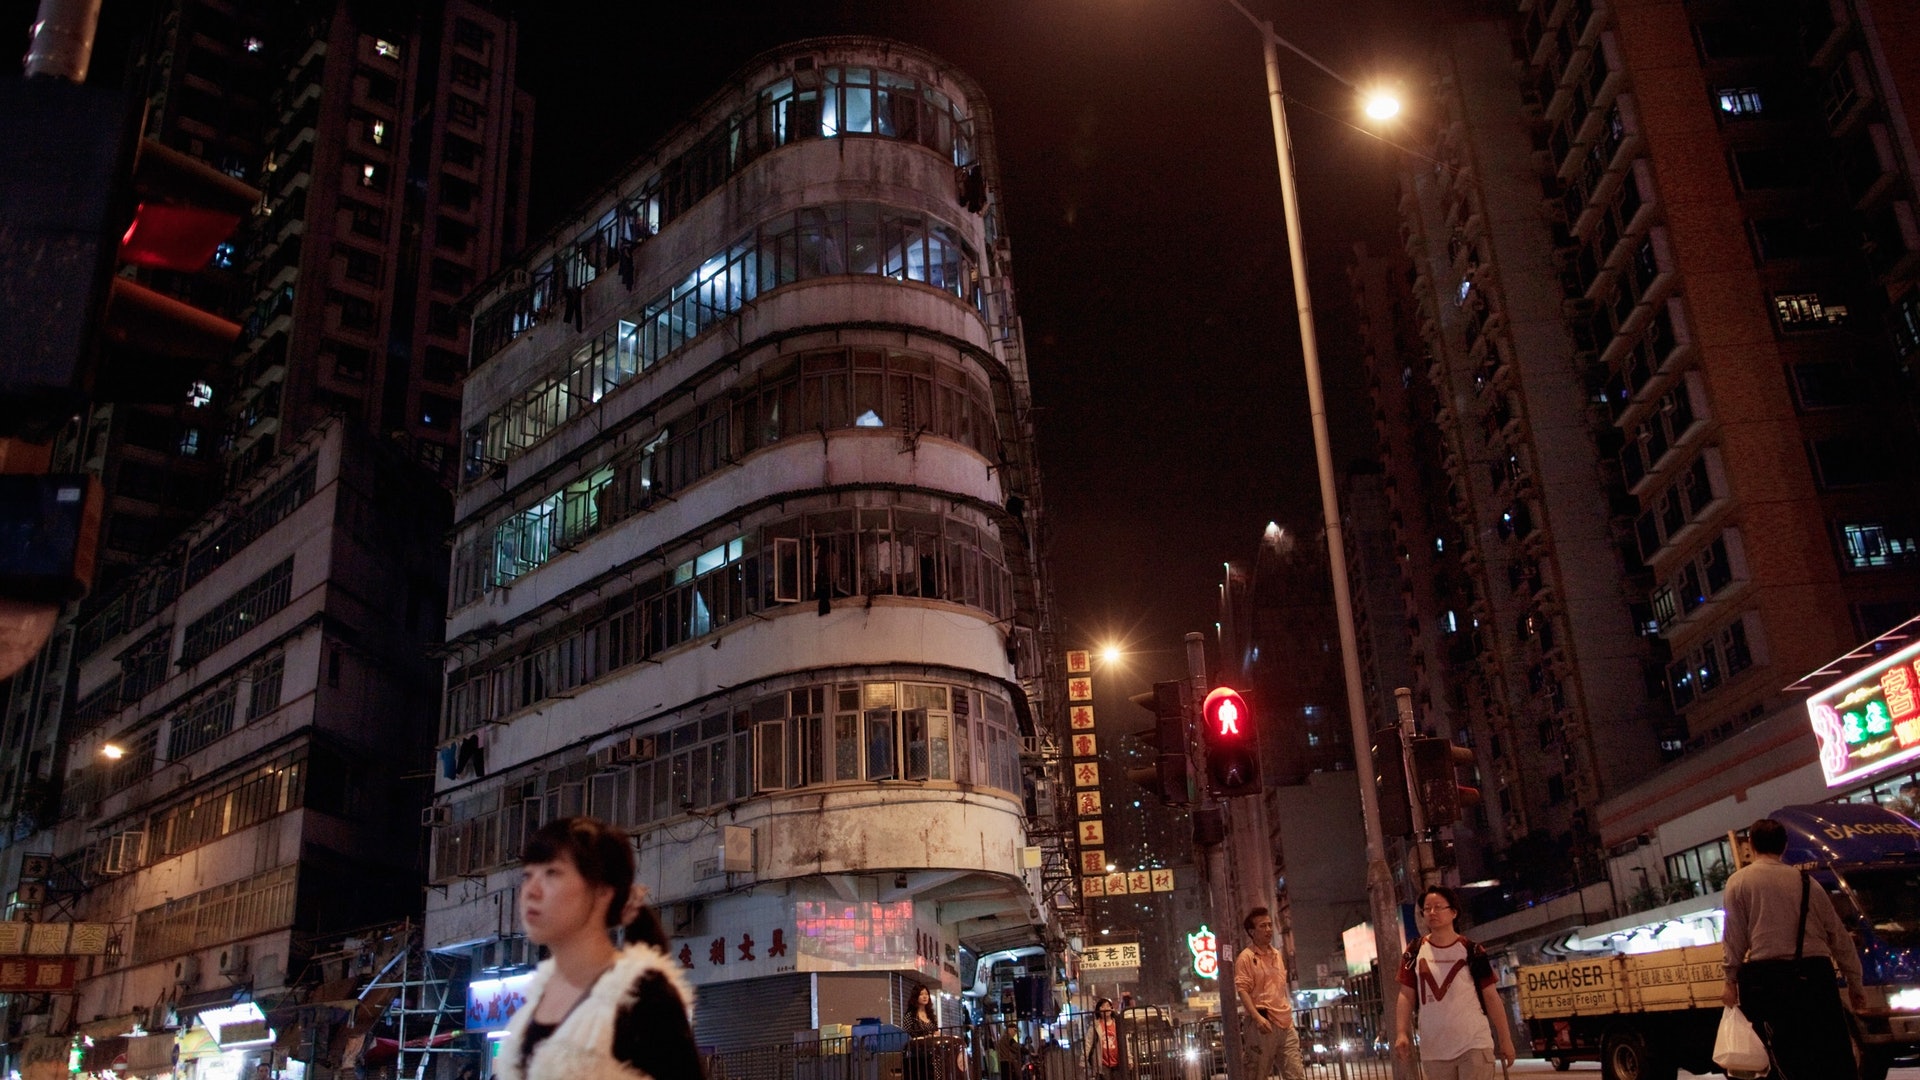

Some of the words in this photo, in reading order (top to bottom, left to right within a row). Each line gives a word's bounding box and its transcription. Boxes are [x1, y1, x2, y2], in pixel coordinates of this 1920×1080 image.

[1083, 872, 1170, 893] 旺興建材
[1528, 965, 1604, 992] DACHSER
[1534, 998, 1545, 1009] Air
[1556, 996, 1572, 1007] Sea
[1575, 992, 1607, 1006] Freight
